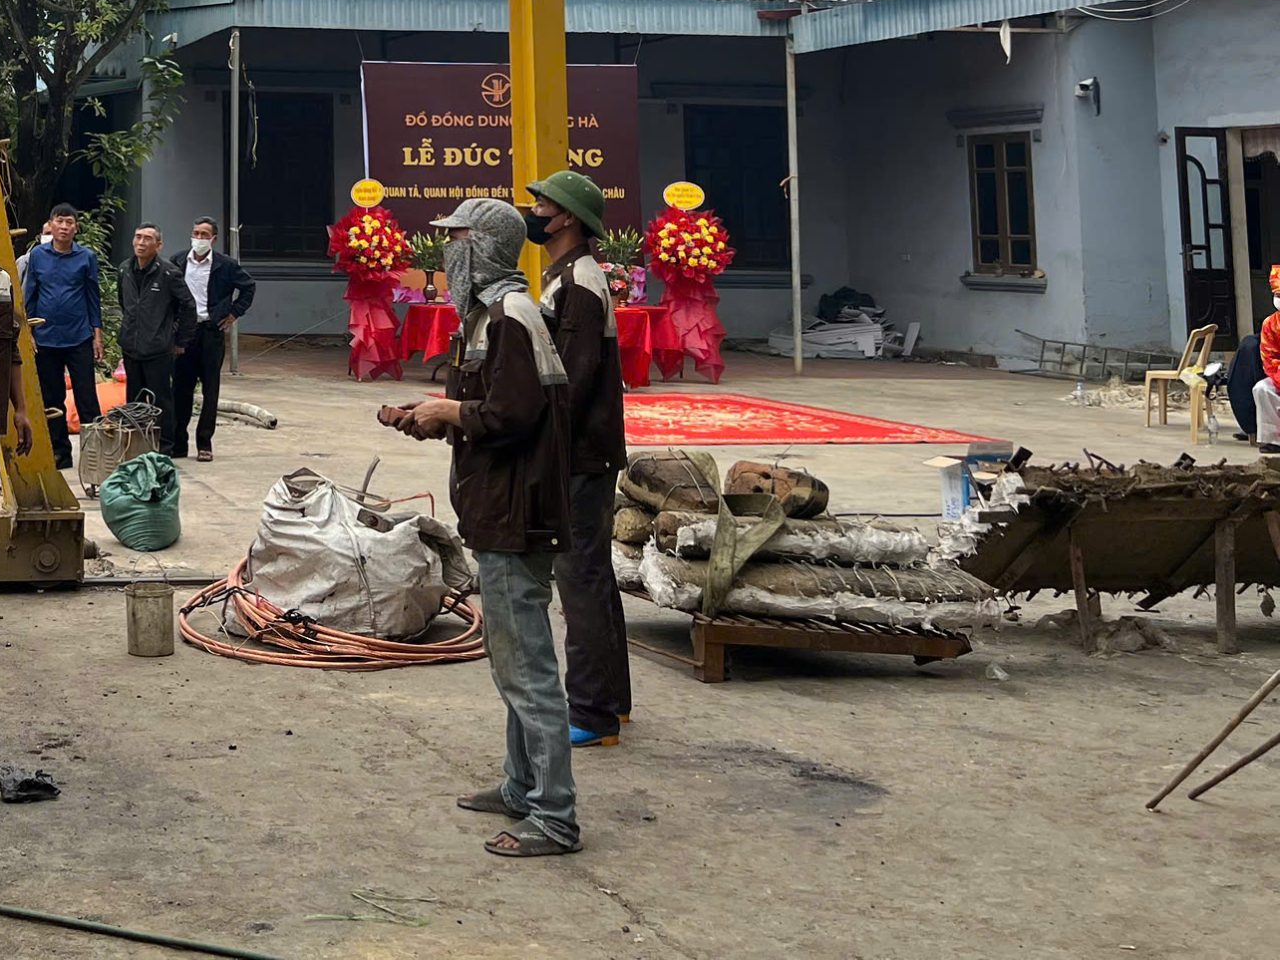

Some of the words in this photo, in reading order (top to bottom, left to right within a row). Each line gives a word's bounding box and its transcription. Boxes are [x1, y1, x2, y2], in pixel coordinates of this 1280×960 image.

[478, 115, 513, 127] DUN
[578, 113, 599, 128] HÀ
[402, 138, 436, 166] LỄ
[443, 143, 501, 166] ĐÚC
[423, 187, 447, 199] QUAN
[602, 186, 625, 199] CHÂU
